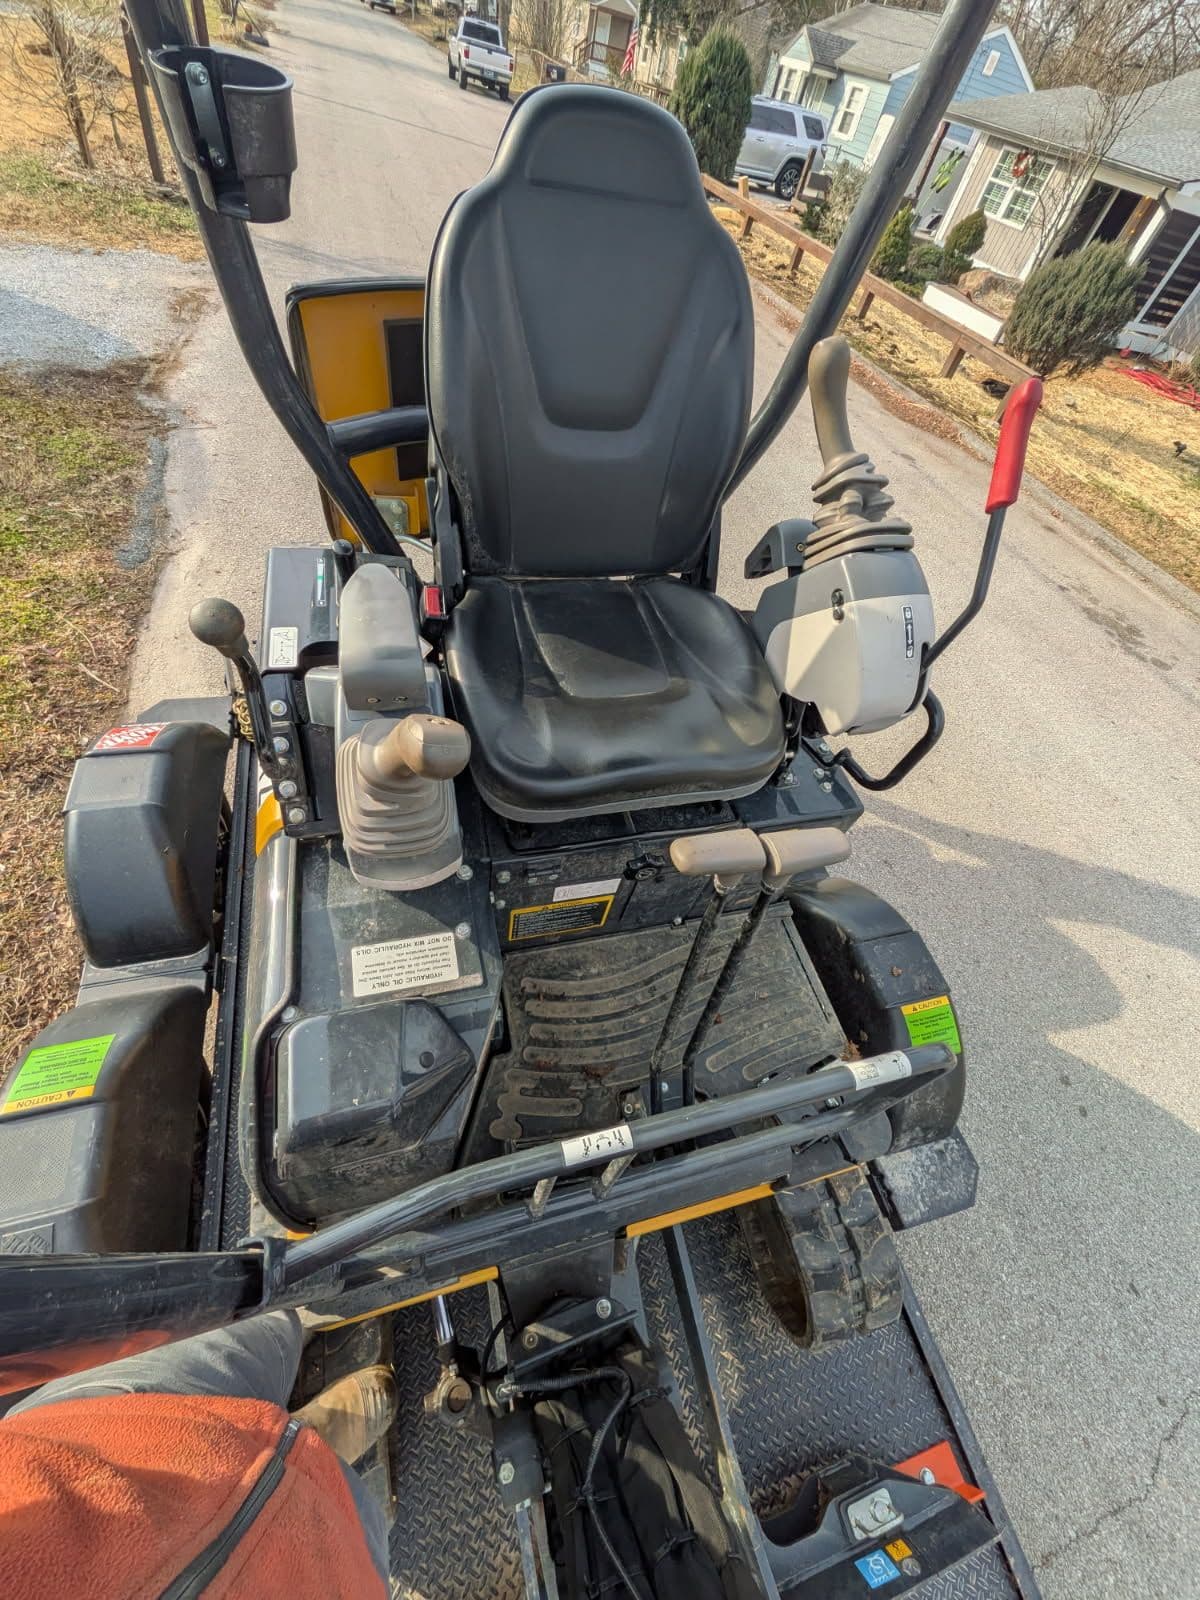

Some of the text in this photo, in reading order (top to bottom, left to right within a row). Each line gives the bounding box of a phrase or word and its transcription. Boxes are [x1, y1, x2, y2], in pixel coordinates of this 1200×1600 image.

[374, 942, 411, 952] HYDRAULIC
[405, 971, 442, 983] HYDRAULIC
[371, 980, 389, 989] ONLY
[16, 1094, 62, 1108] CAUTION
